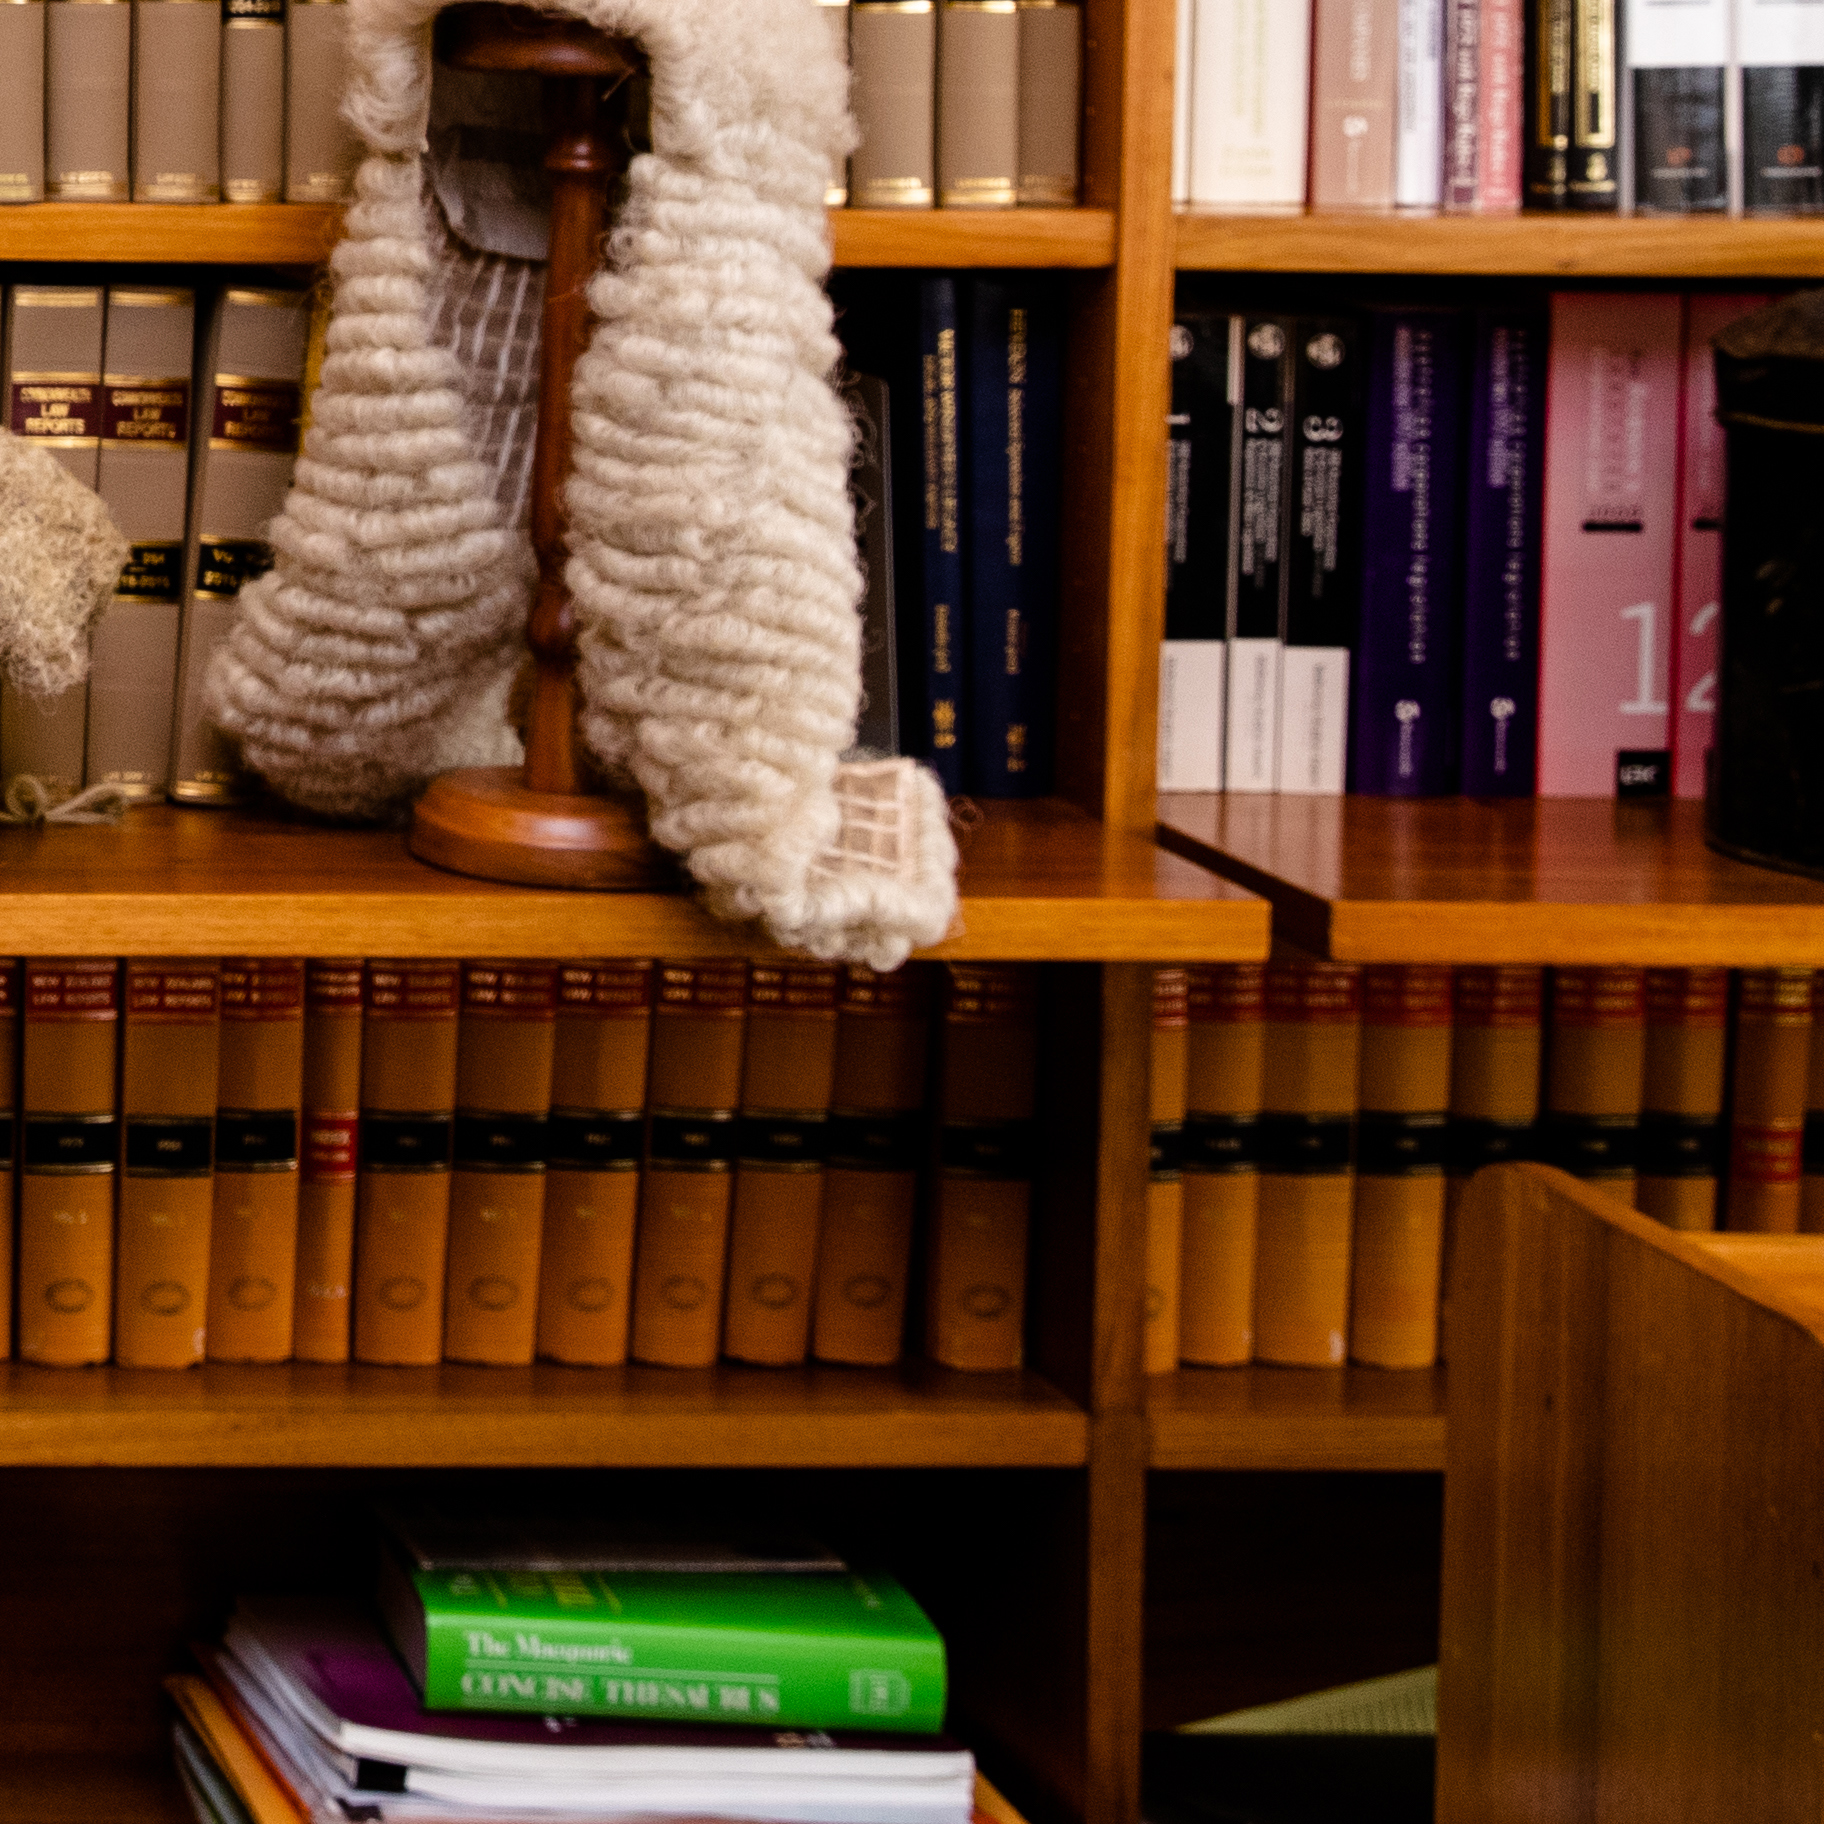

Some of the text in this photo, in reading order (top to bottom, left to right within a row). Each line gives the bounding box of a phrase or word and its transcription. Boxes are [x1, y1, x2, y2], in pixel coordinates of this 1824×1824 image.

[1245, 407, 1284, 433] 2
[1303, 415, 1343, 442] 3
[467, 1633, 633, 1664] The Macquarie
[461, 1673, 780, 1713] CONCISE THESAURUS
